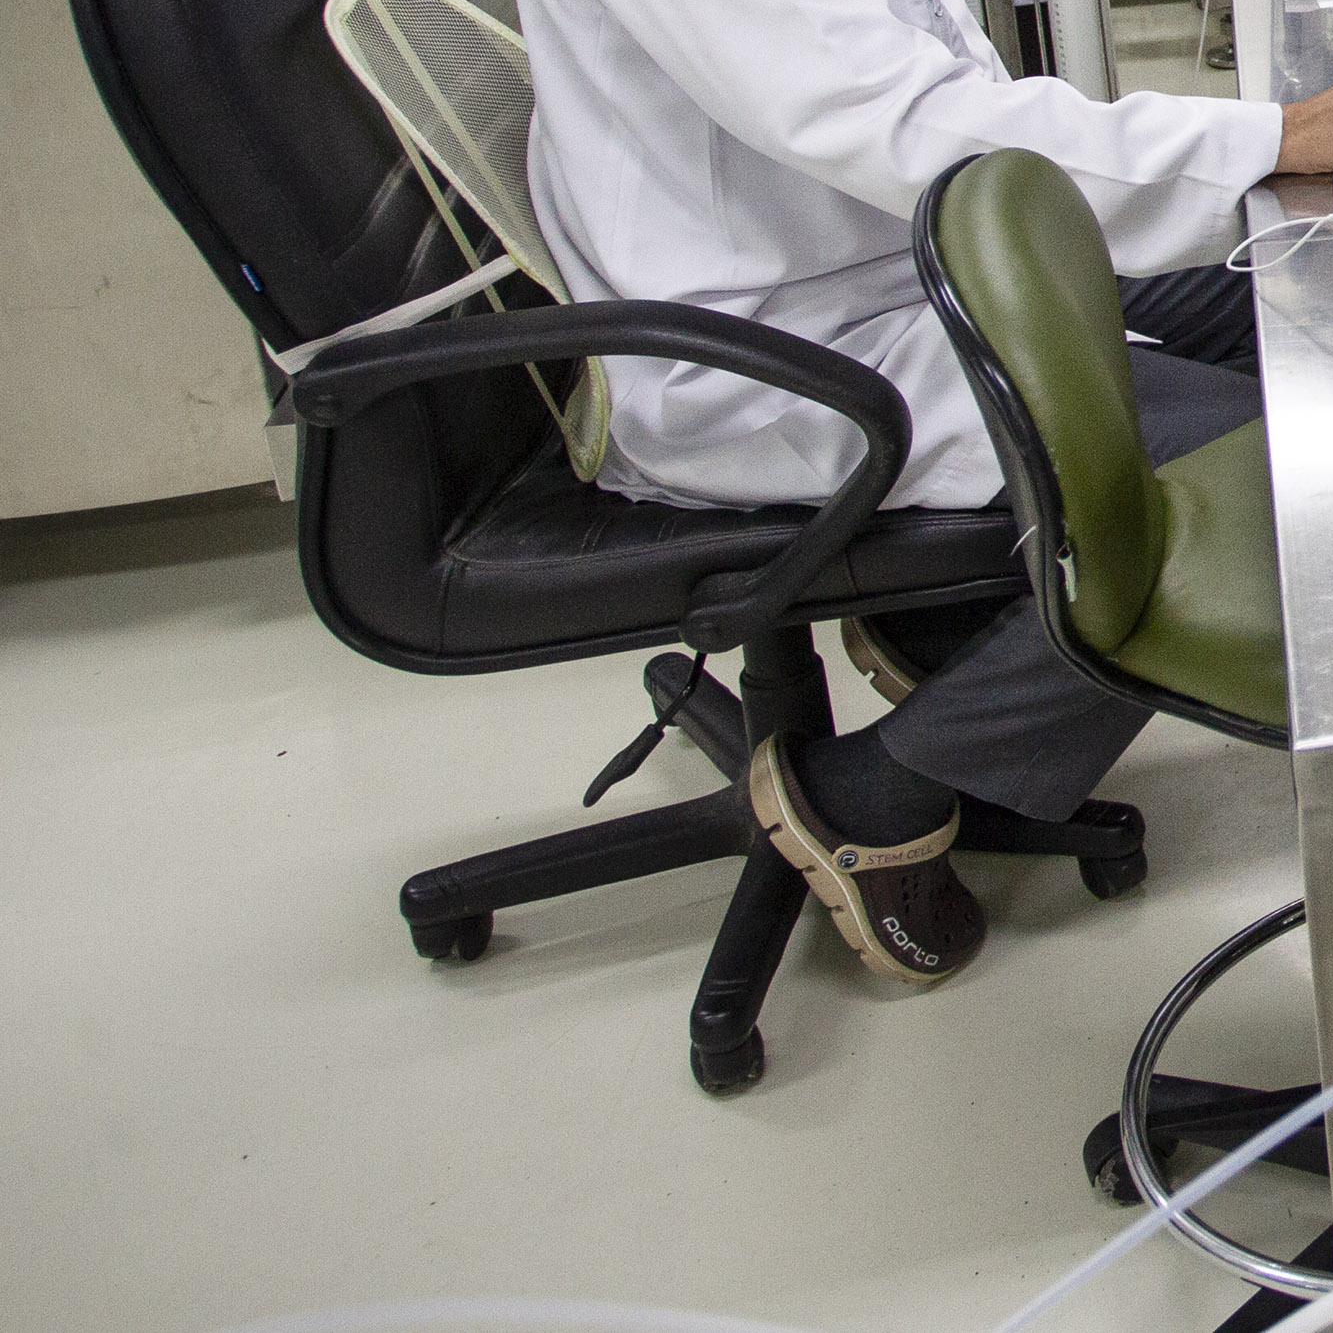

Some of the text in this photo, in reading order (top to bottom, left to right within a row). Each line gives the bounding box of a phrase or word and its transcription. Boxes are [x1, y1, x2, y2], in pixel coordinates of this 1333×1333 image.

[865, 847, 934, 866] STEM CELL
[882, 917, 939, 966] porto
